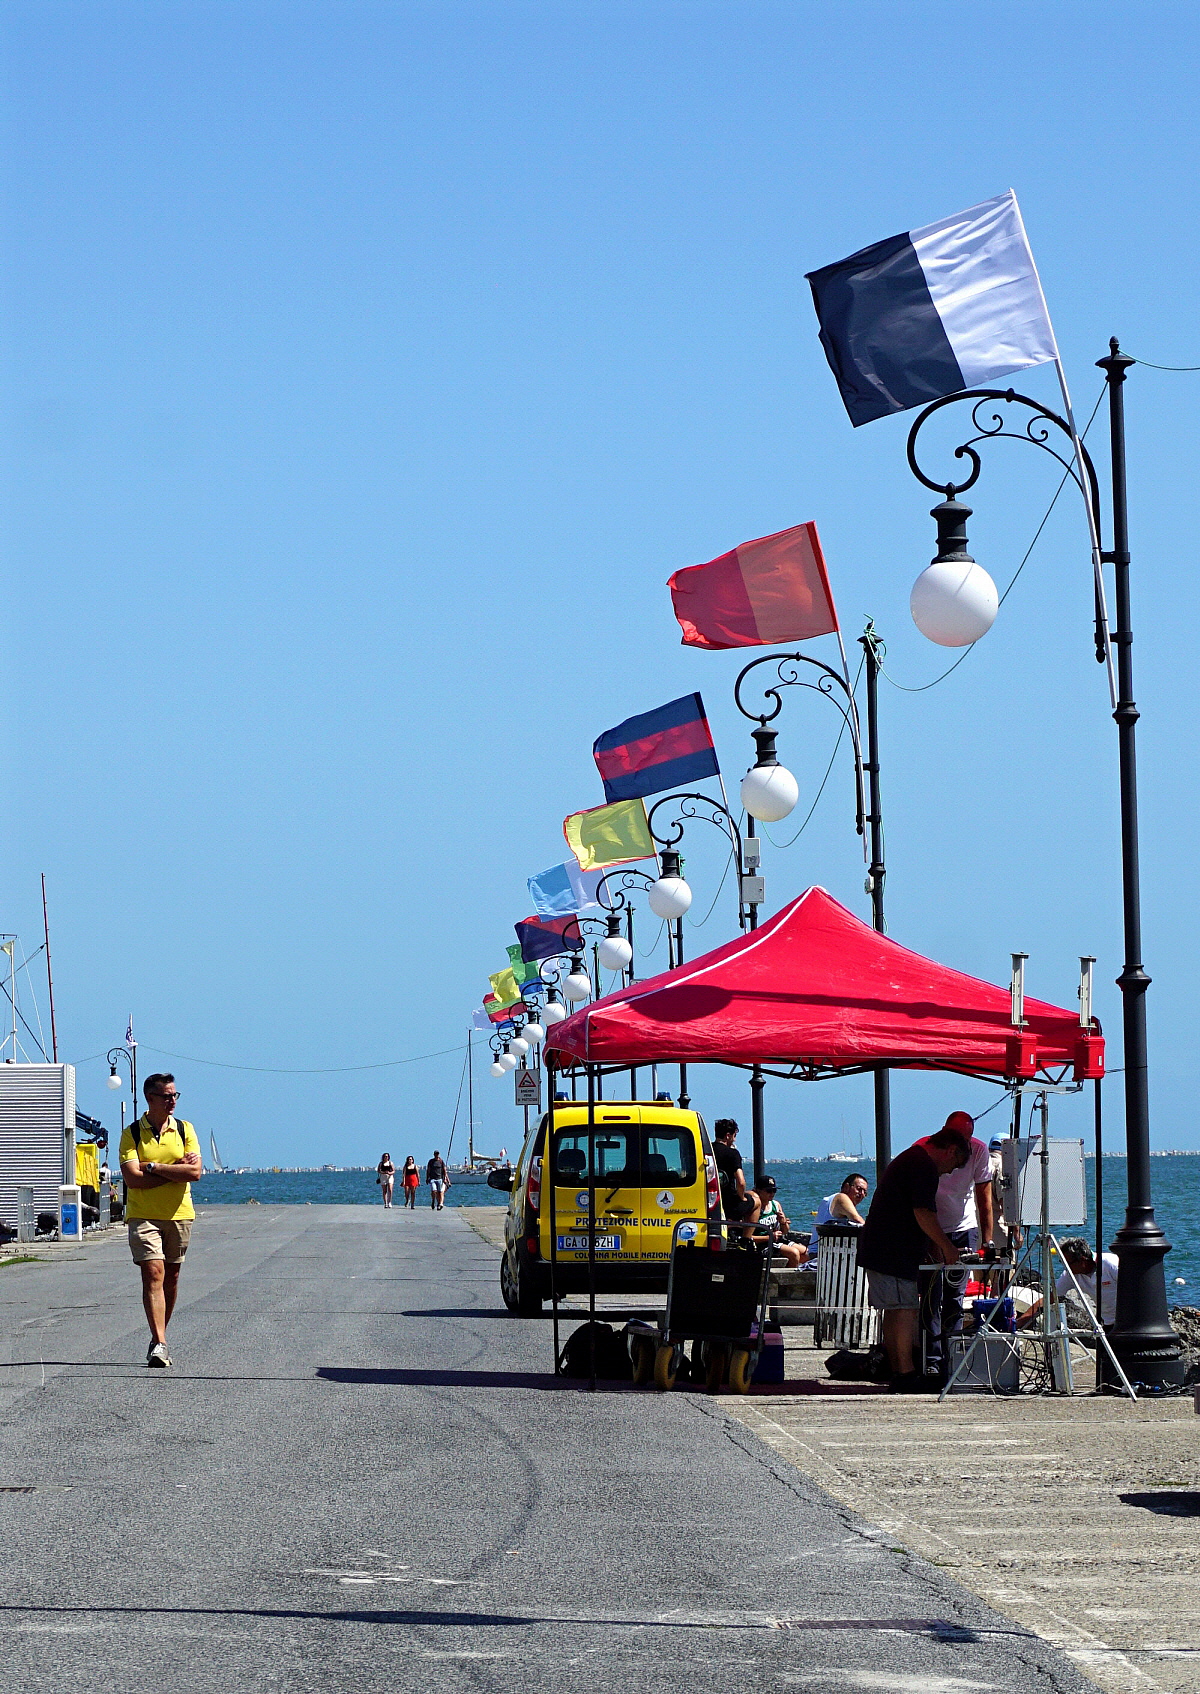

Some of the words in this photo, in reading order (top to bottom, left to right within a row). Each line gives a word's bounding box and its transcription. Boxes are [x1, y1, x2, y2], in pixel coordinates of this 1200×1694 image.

[576, 1217, 639, 1226] PRTEZIONE
[642, 1218, 671, 1227] CIVILE
[565, 1237, 577, 1247] GA
[582, 1237, 613, 1247] 06ZH
